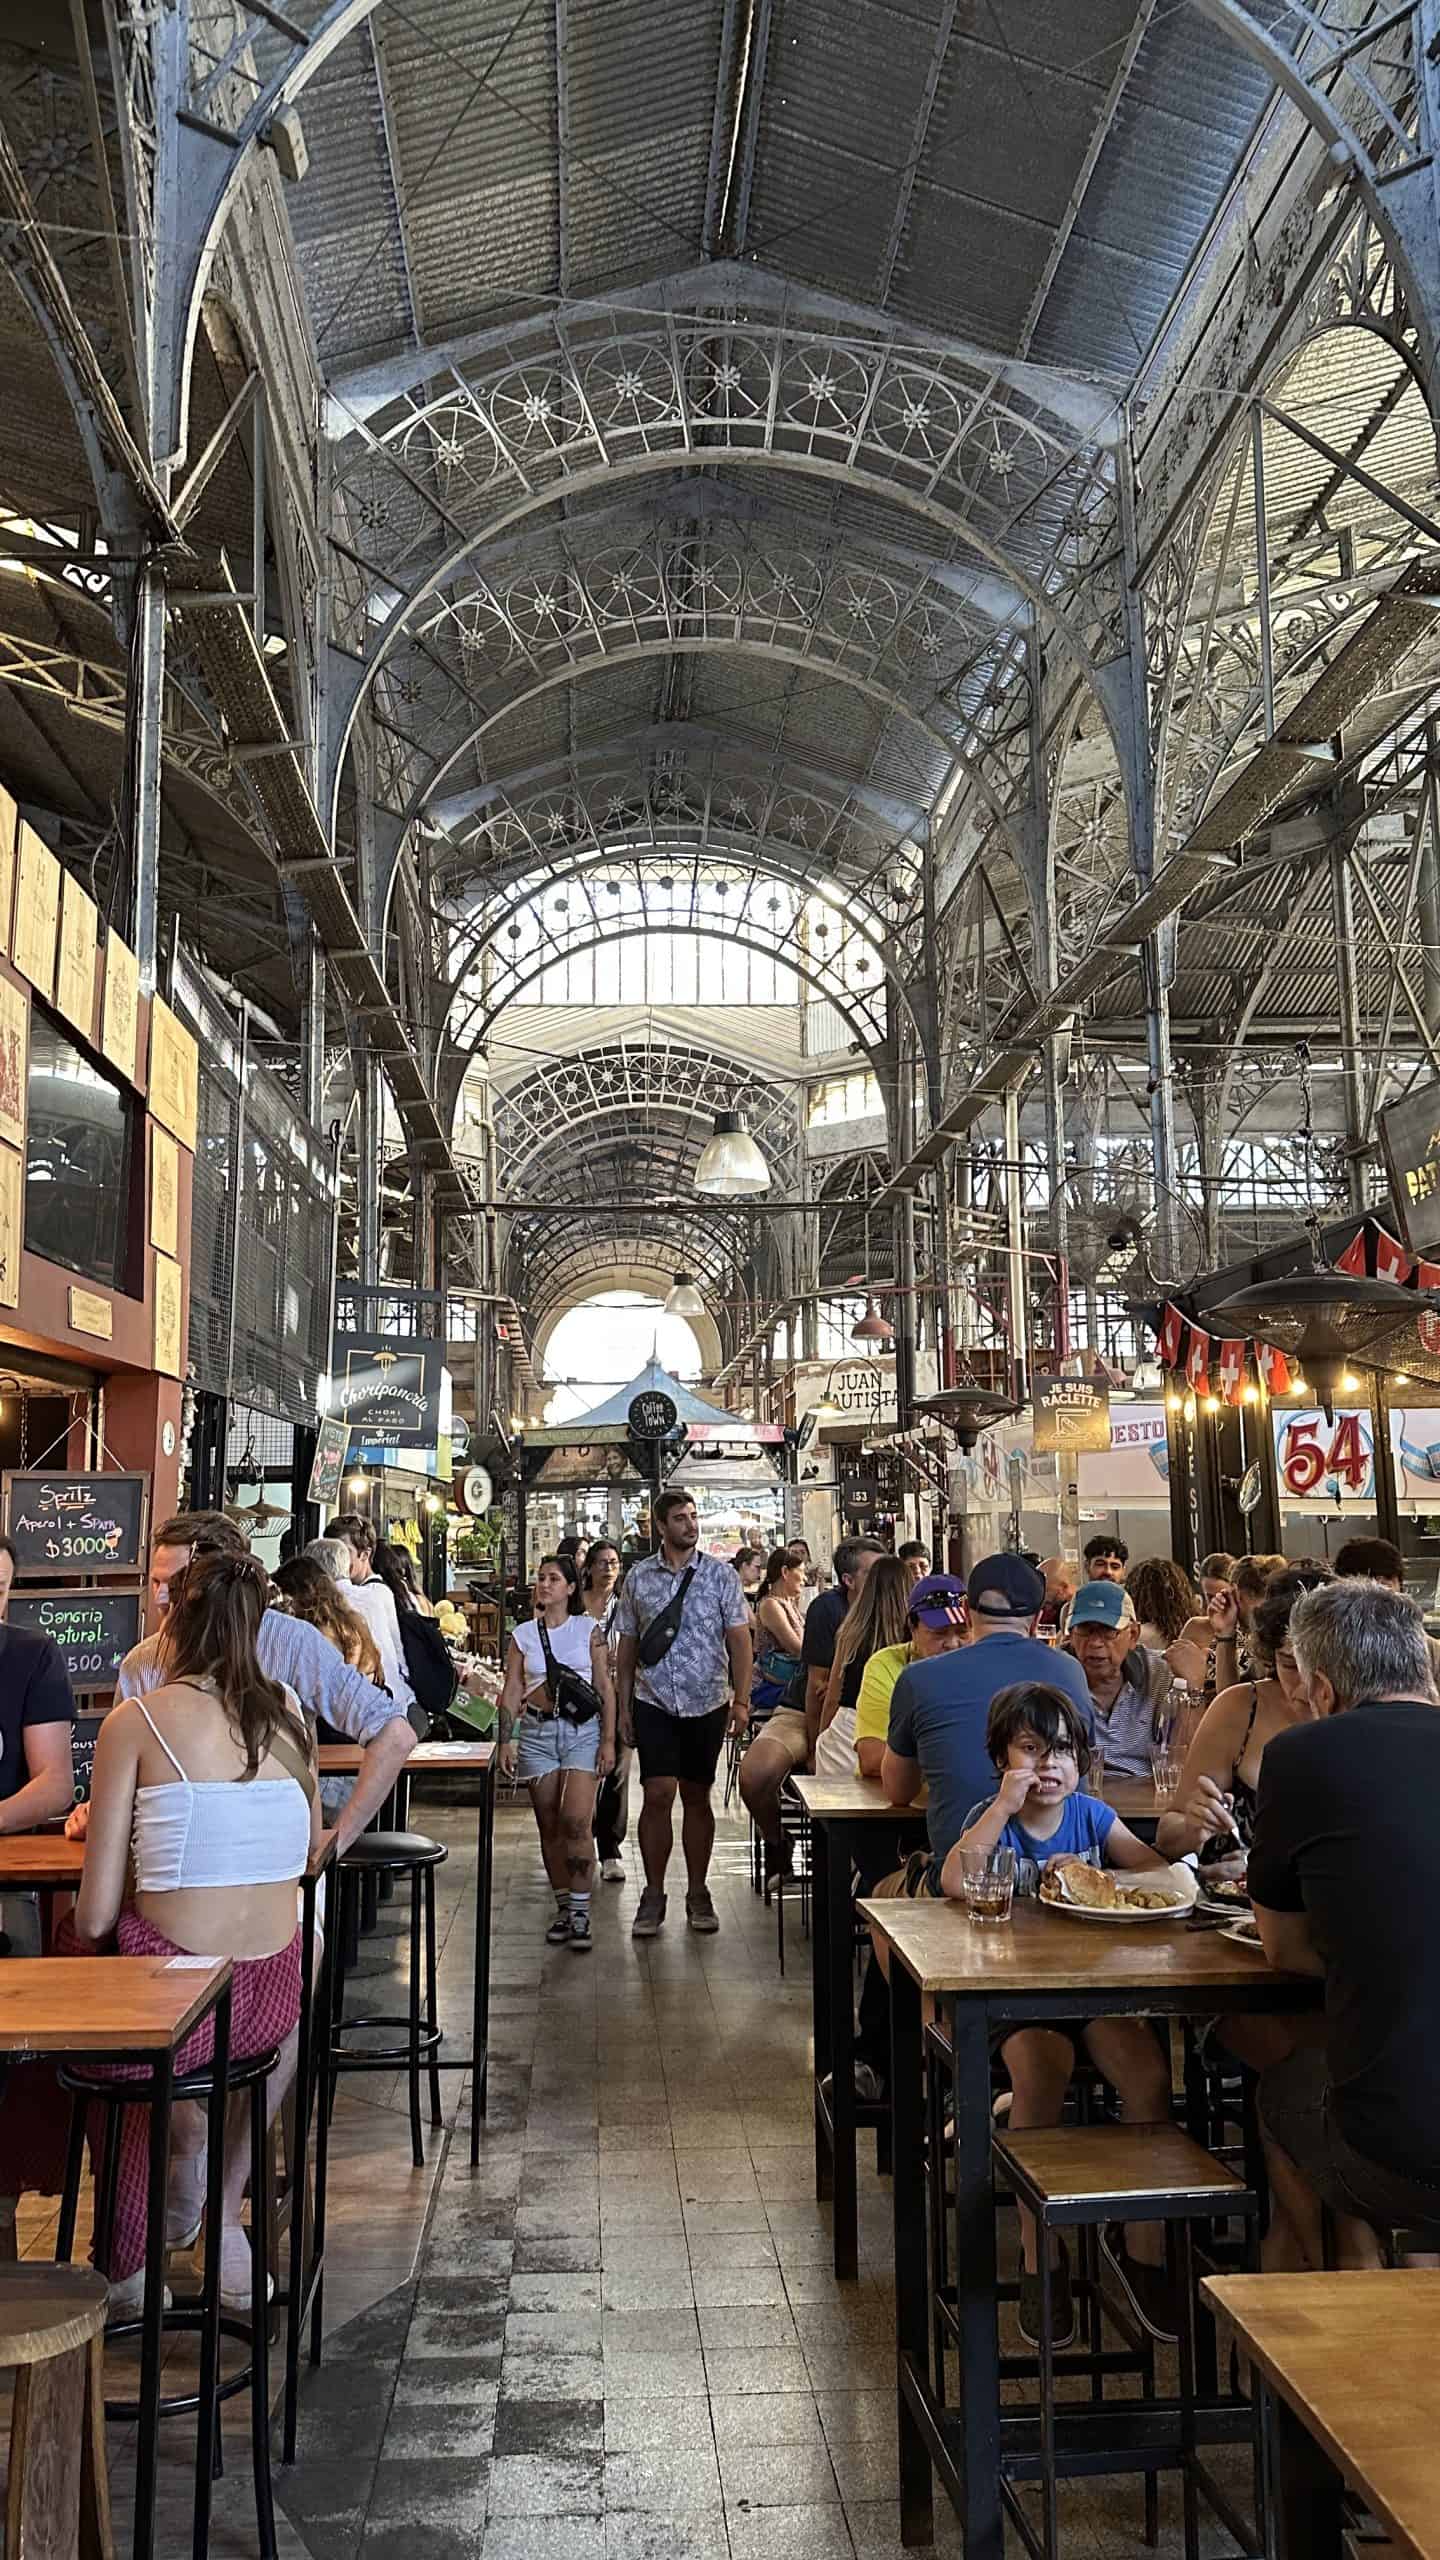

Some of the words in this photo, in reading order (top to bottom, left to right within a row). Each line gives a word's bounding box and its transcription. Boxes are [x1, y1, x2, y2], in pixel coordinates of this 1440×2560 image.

[838, 1373, 882, 1390] JUAN
[1049, 1383, 1062, 1394] JE
[1065, 1383, 1094, 1395] SUIS
[820, 1391, 898, 1409] AUTIST
[1041, 1394, 1102, 1408] RACLETTE
[1283, 1413, 1370, 1497] 54
[16, 1514, 61, 1533] Aperol
